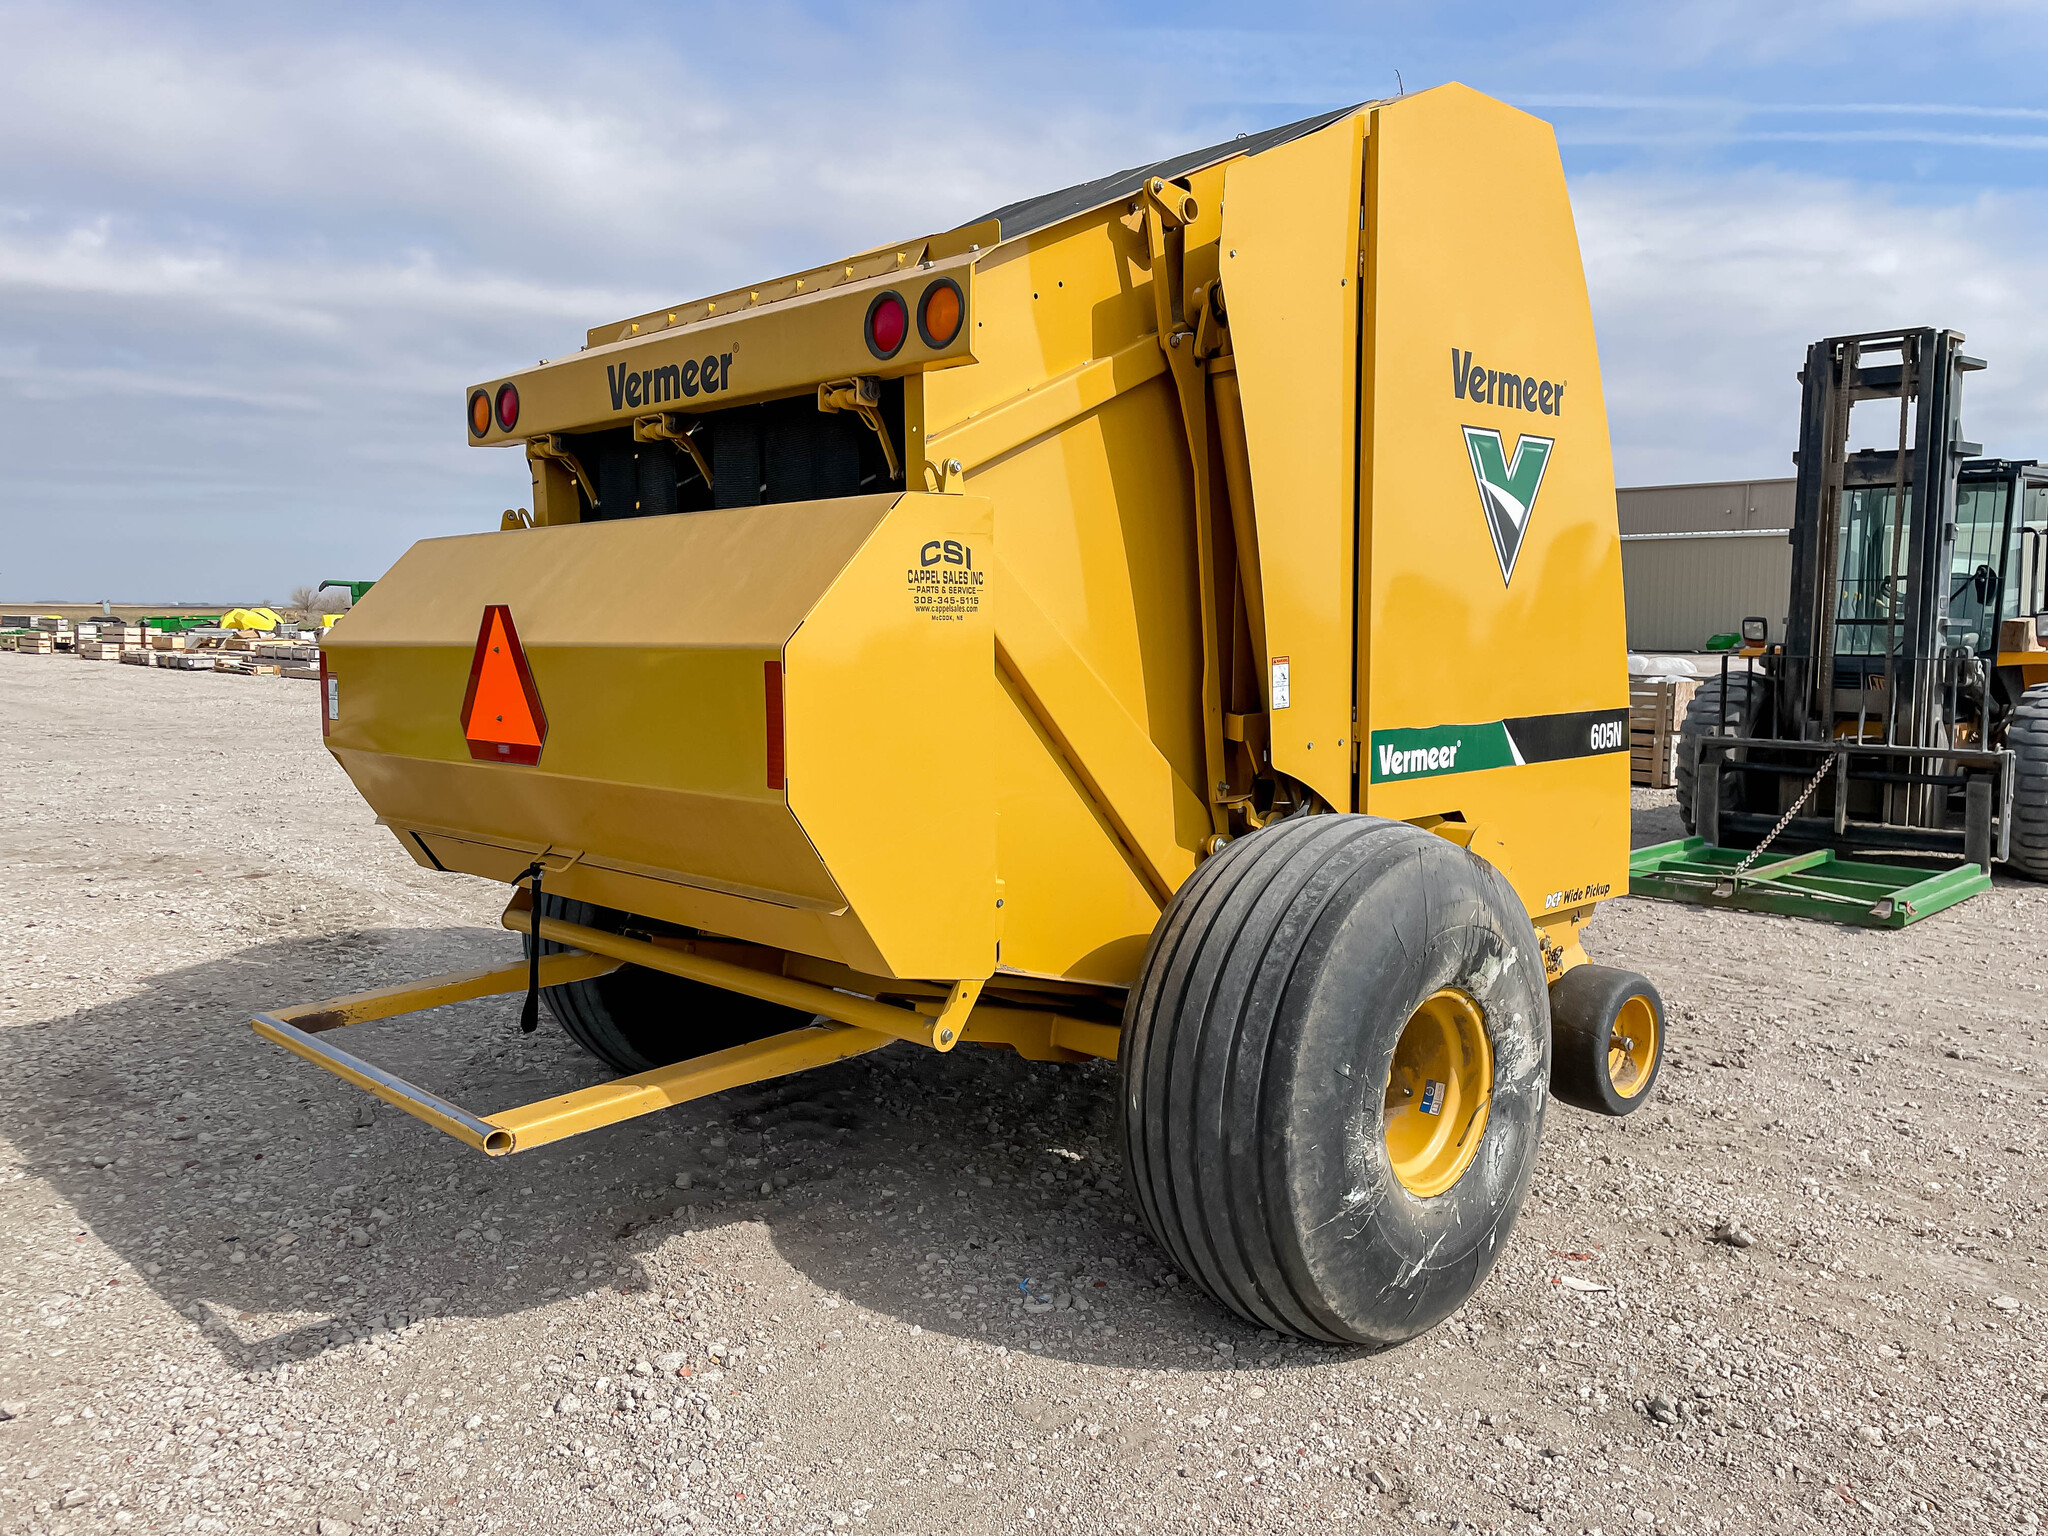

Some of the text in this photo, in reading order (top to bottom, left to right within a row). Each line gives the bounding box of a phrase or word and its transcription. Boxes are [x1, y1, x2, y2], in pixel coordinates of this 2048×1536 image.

[607, 352, 733, 411] Vermeer
[1451, 347, 1564, 417] Vermeer
[920, 540, 972, 570] CSI
[907, 569, 984, 585] CAPPEL SALES INC
[916, 586, 976, 595] PARTS & SERVICE
[913, 596, 979, 605] 308-345-5115
[915, 604, 978, 614] www.cappelsales.com
[1590, 720, 1623, 751] 605N
[1378, 742, 1458, 776] Vermeer
[1544, 882, 1611, 910] DCF Wide Pickup
